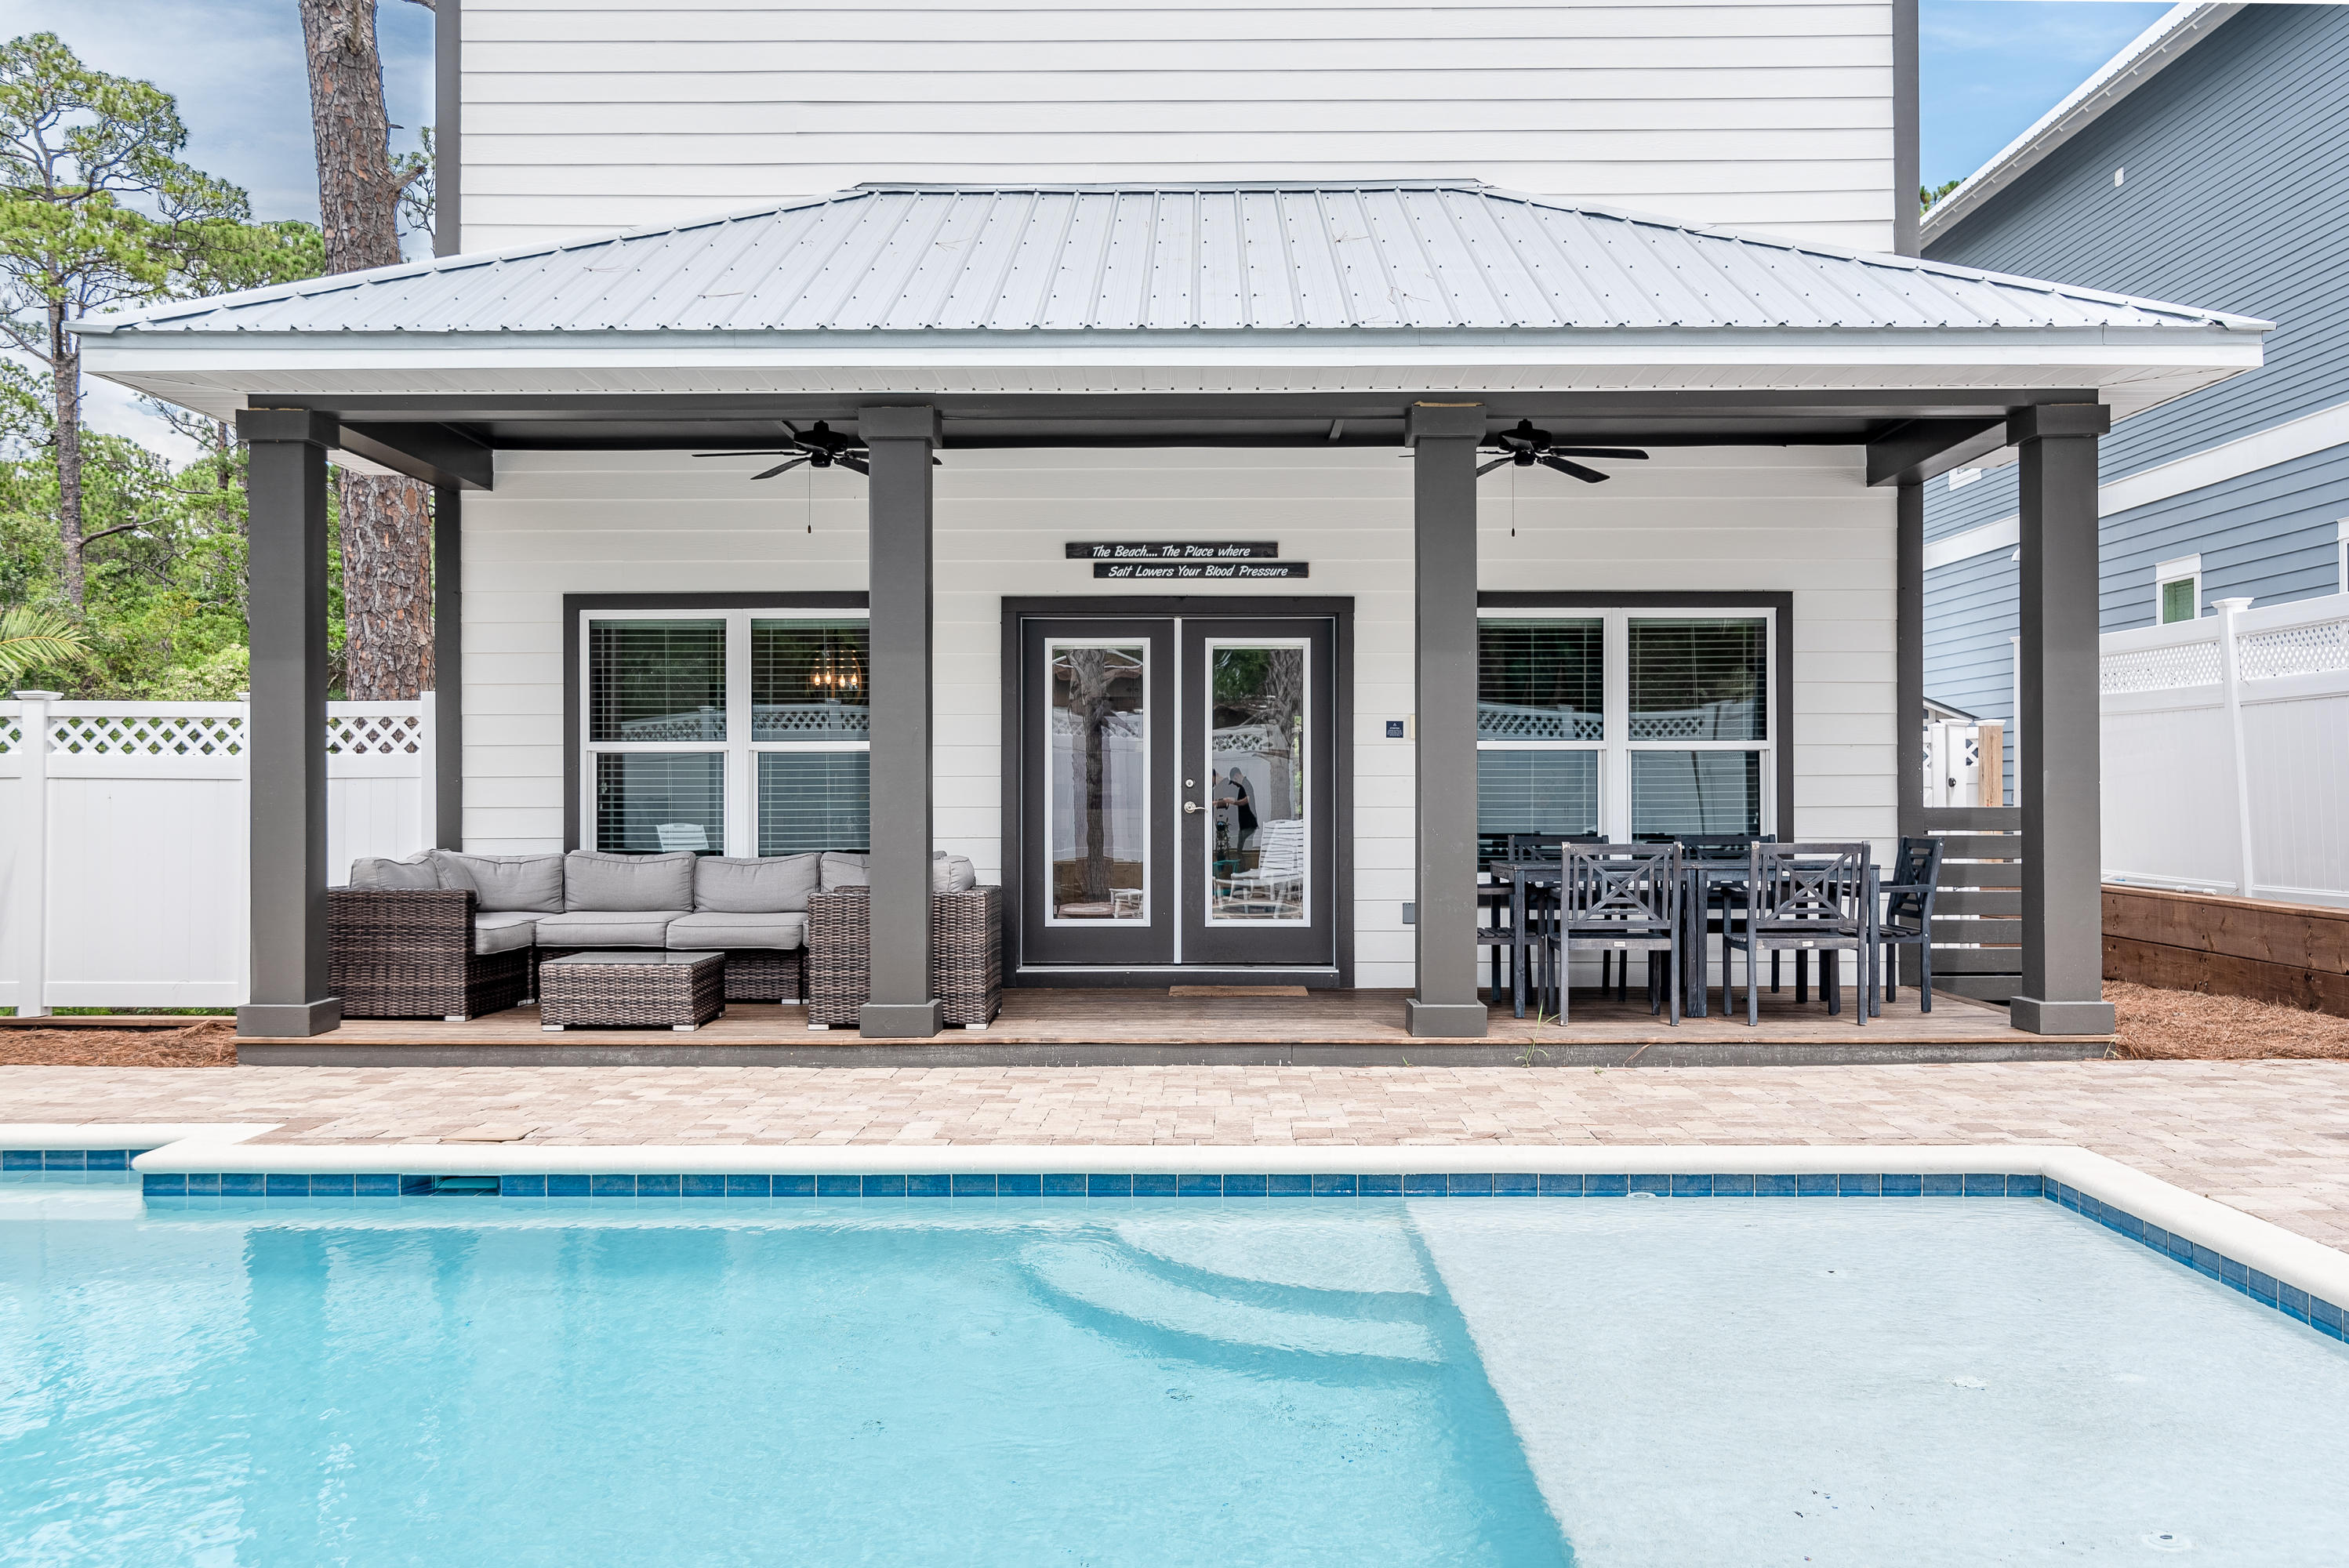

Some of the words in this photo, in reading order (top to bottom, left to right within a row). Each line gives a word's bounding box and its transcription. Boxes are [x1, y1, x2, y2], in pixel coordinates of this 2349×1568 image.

[1093, 545, 1111, 557] The
[1162, 545, 1181, 557] The
[1184, 545, 1214, 557] Place
[1218, 545, 1251, 557] where
[1108, 565, 1133, 577] Salt
[1135, 565, 1174, 577] Lowers
[1178, 565, 1202, 577] Your
[1205, 564, 1236, 576] Blood
[1239, 565, 1289, 576] Pressure
